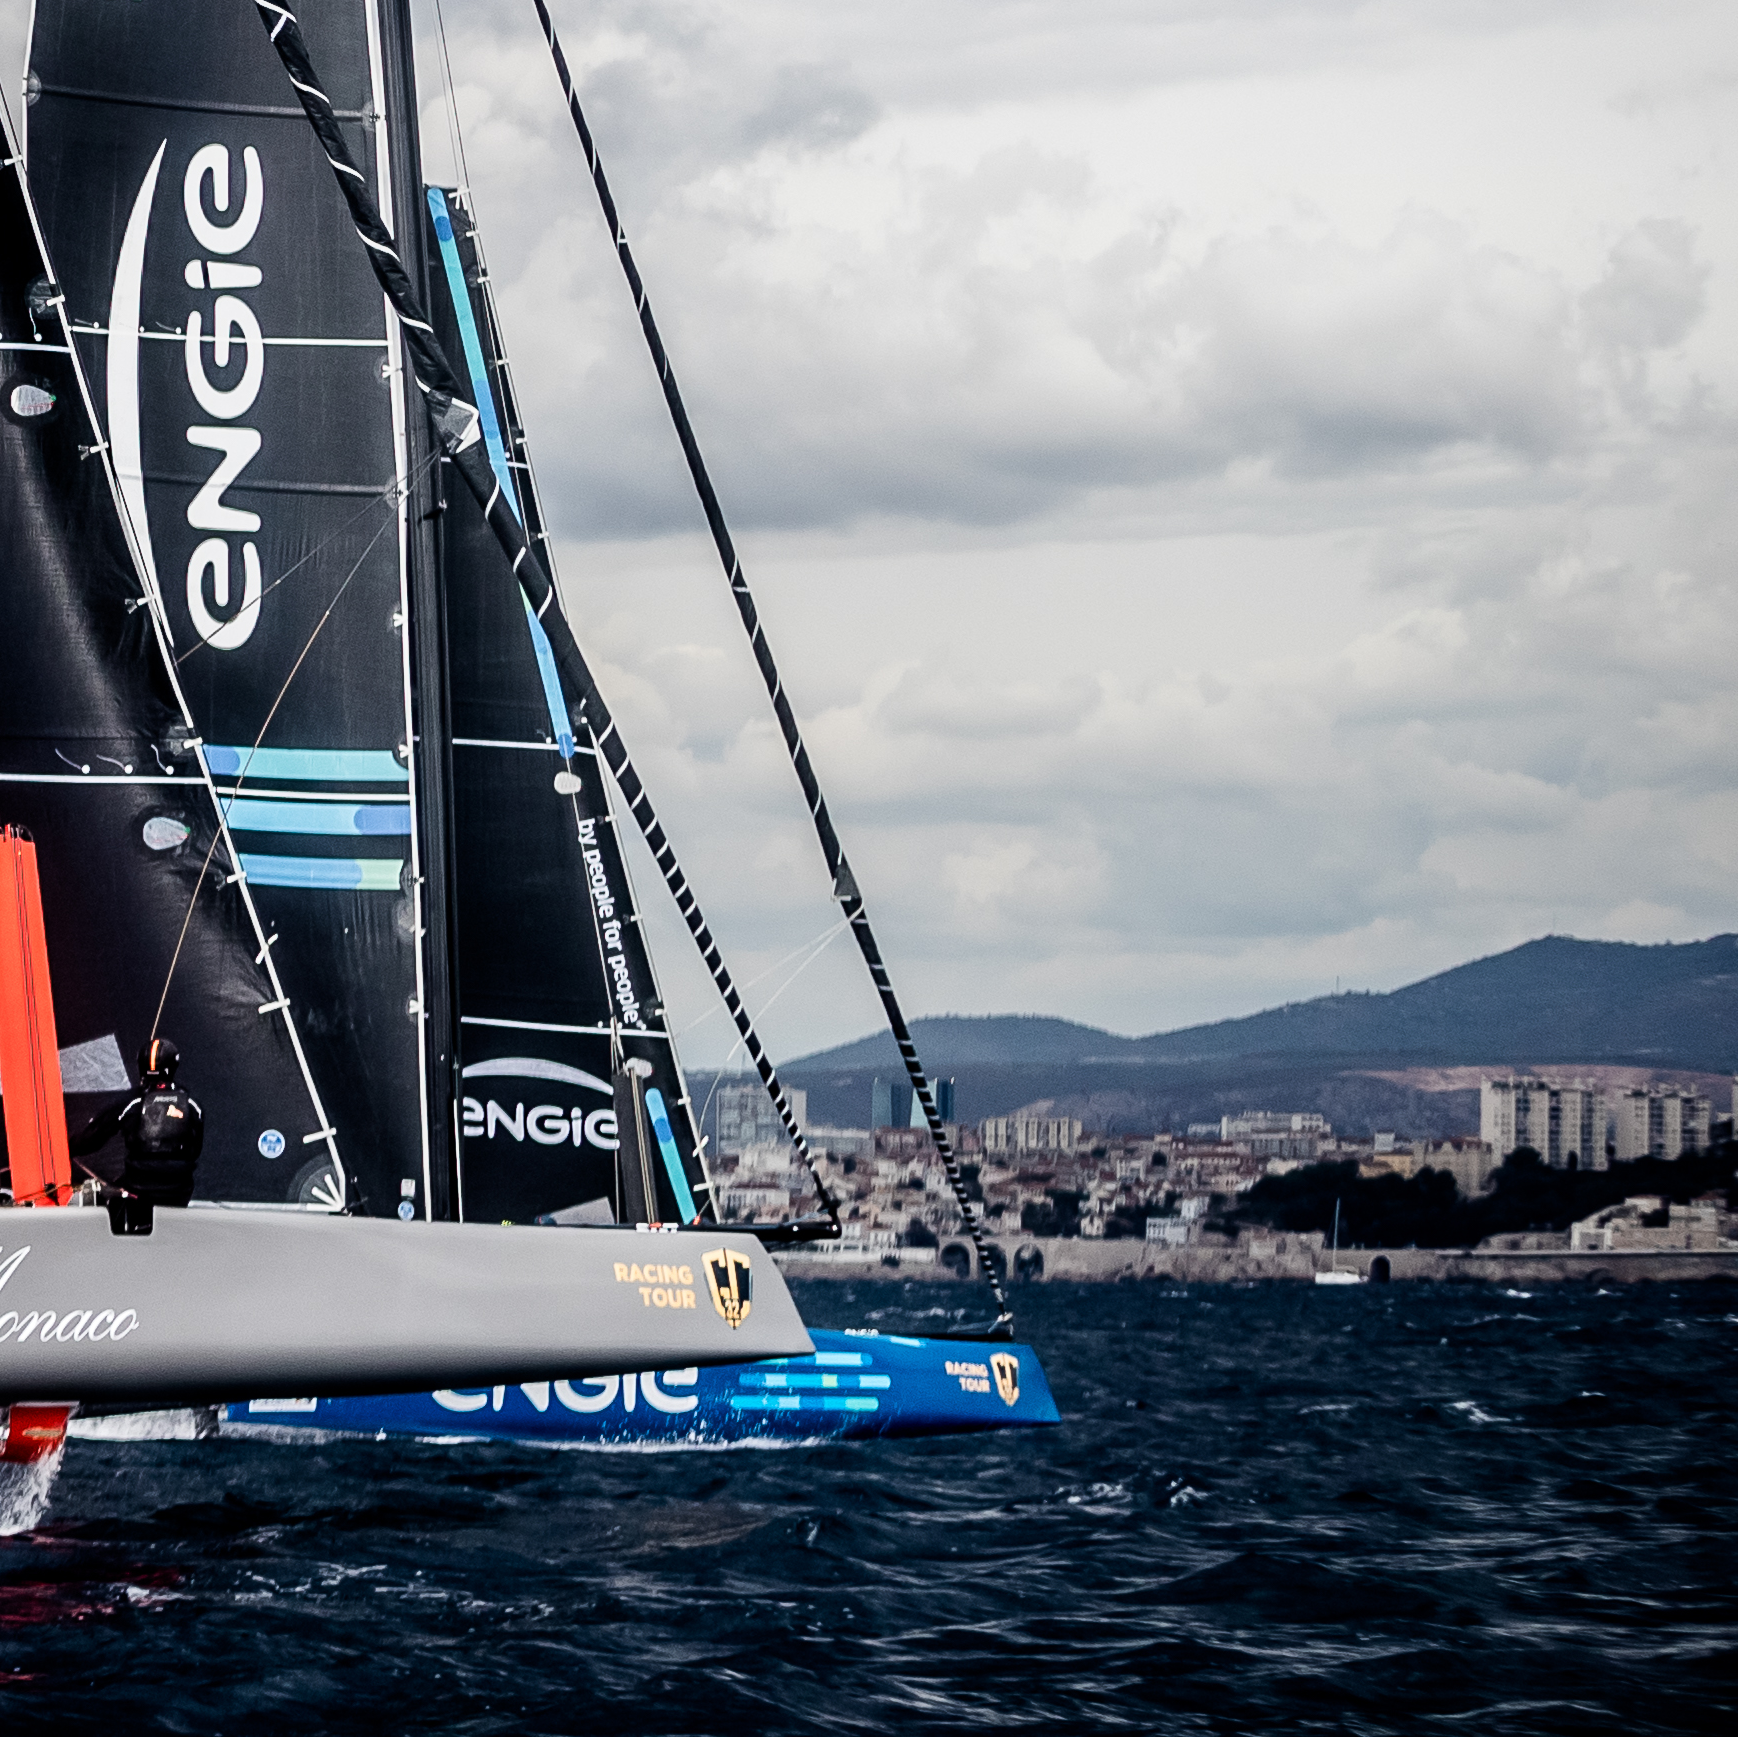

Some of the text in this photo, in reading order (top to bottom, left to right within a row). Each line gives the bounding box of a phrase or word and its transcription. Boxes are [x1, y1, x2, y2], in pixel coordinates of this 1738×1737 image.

[577, 817, 598, 846] by
[582, 848, 615, 919] people
[602, 919, 623, 952] for
[612, 1261, 695, 1286] RACING
[638, 1285, 697, 1310] TOUR
